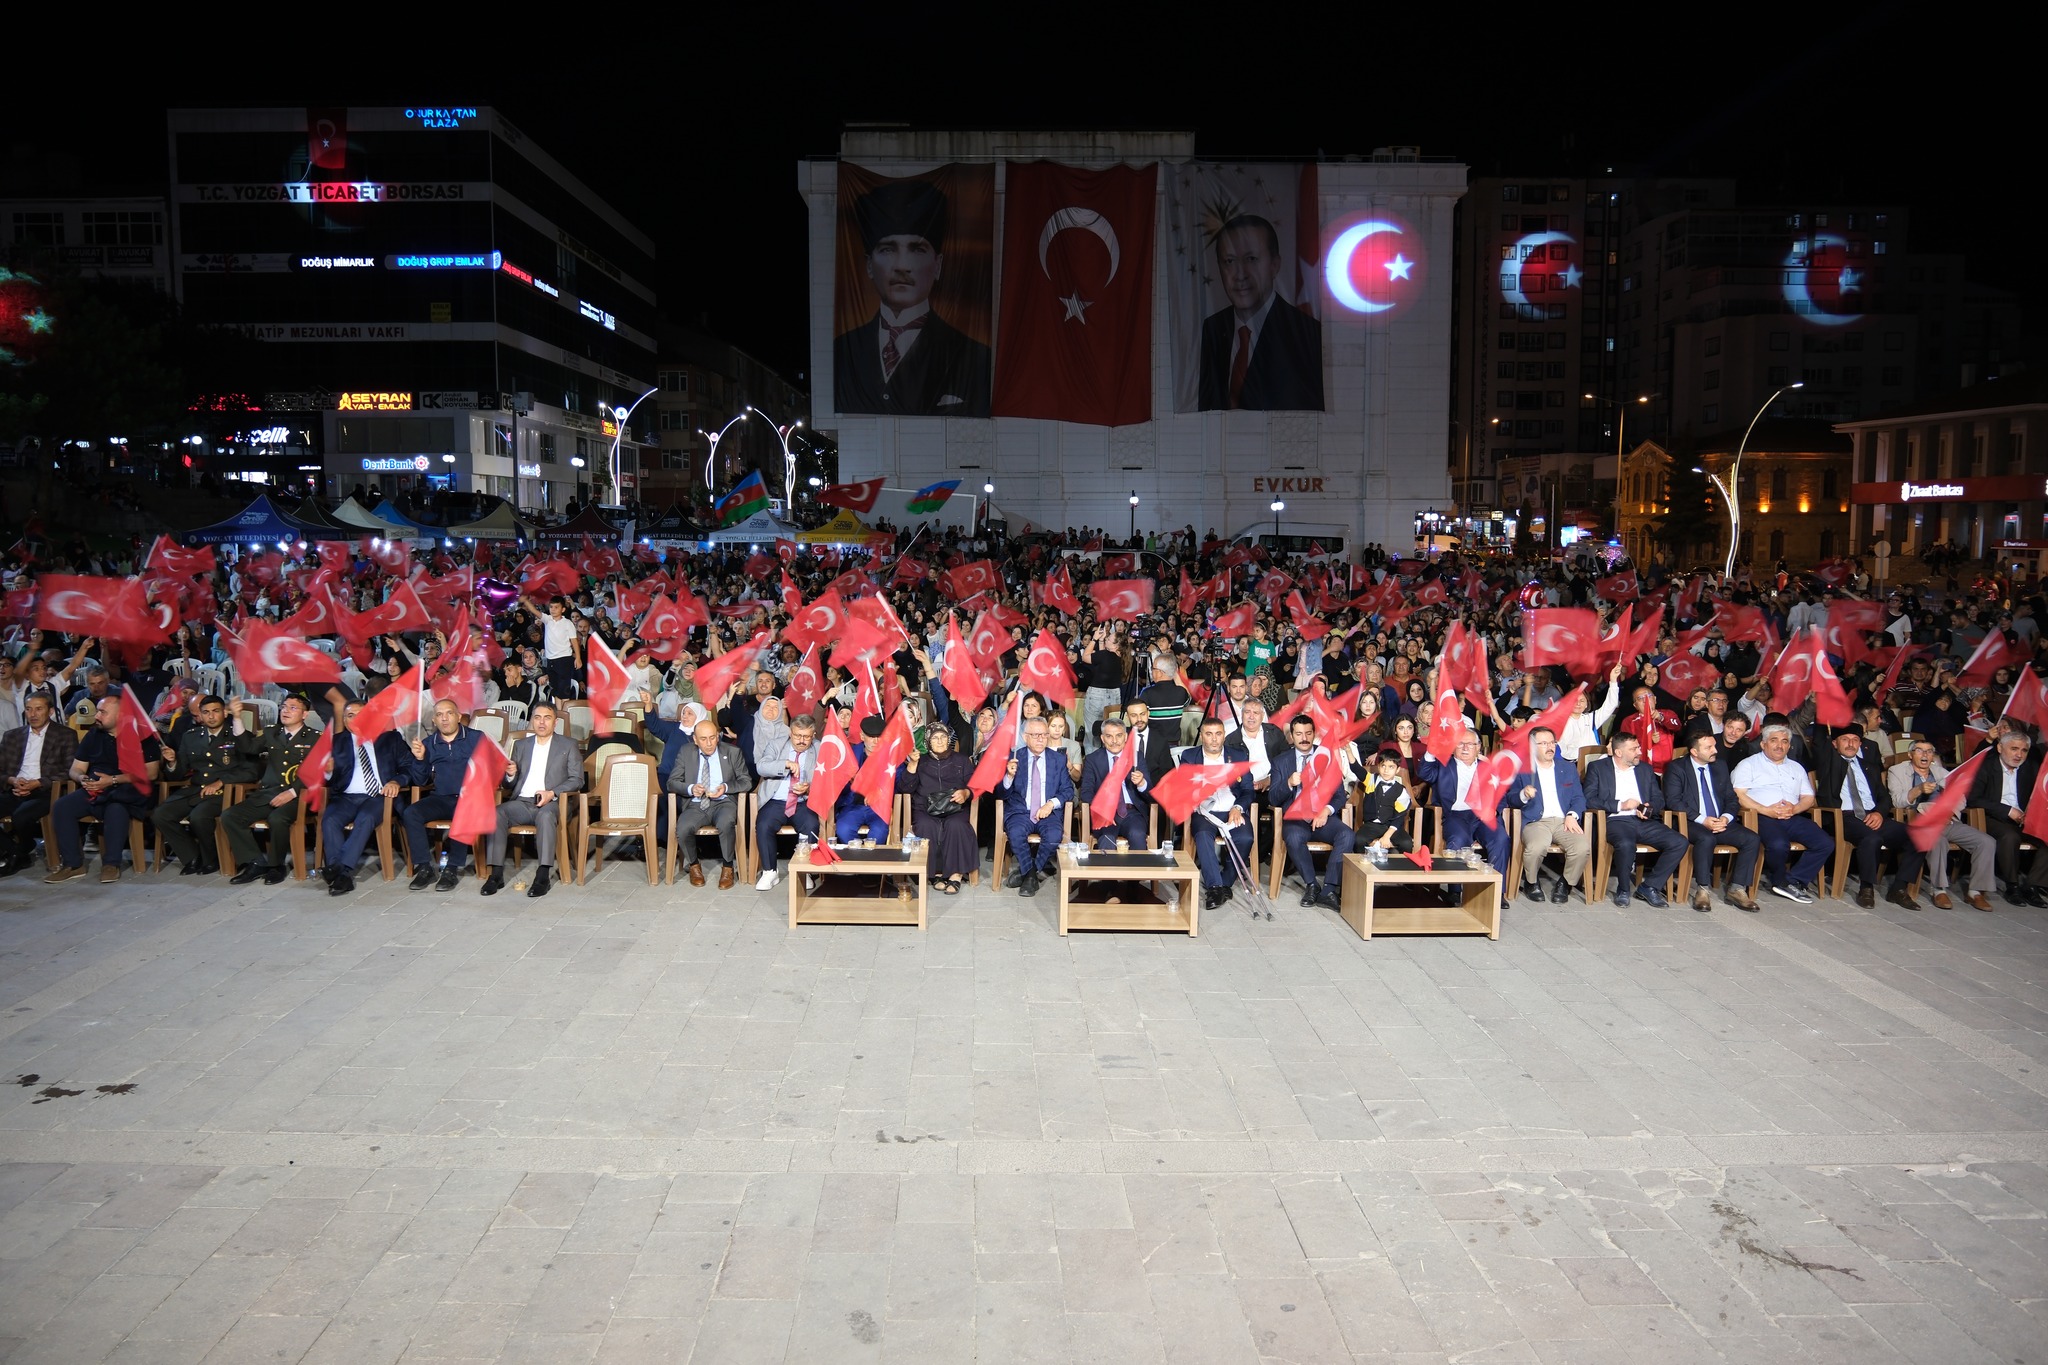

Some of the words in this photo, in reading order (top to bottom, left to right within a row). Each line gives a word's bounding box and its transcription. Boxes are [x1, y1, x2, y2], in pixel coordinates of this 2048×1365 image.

[423, 119, 459, 127] PLAZA
[197, 186, 229, 200] T.C.
[232, 185, 301, 200] YOZGAT
[306, 183, 382, 199] TİCARET
[387, 185, 463, 199] BORSASI
[68, 248, 101, 257] AVUKAT
[118, 248, 151, 257] AVUKAT
[301, 257, 332, 268] DOĞUŞ
[333, 257, 374, 267] MİMARLIK
[398, 257, 428, 268] DOĞUŞ
[429, 258, 453, 267] GRUP
[455, 257, 485, 266] EMLAK
[291, 327, 361, 338] MEZUNLARI
[368, 327, 405, 338] VAKFI
[351, 393, 411, 403] SEYRAN
[362, 459, 414, 470] DenizBank
[1254, 477, 1324, 493] EVKUR
[1910, 485, 1933, 497] Ziraat
[1933, 484, 1964, 496] Bankası
[234, 534, 280, 542] BELEDİYESİ
